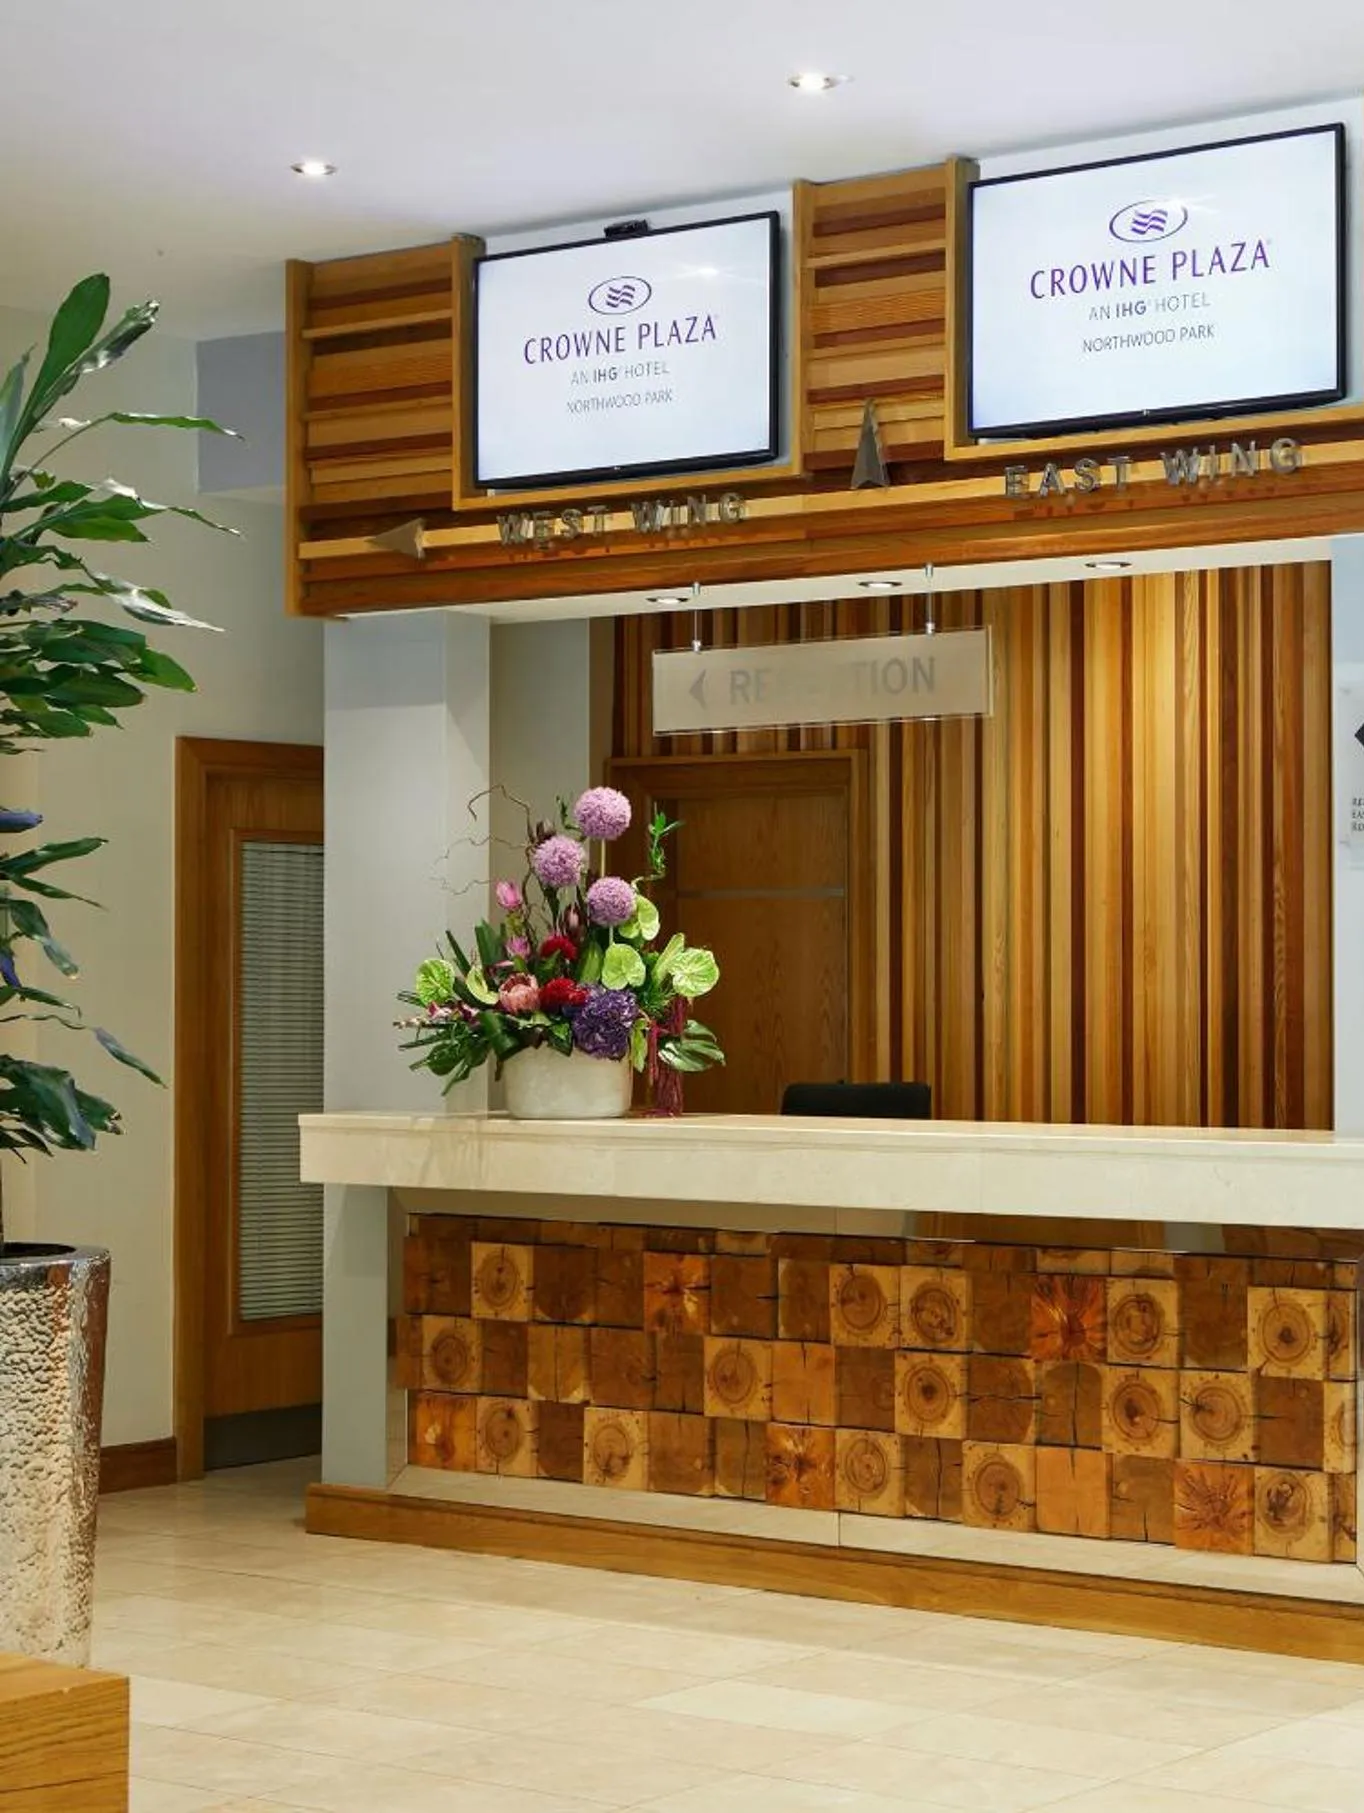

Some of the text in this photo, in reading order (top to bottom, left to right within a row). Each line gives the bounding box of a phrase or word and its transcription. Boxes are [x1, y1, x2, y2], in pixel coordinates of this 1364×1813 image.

[1030, 238, 1270, 300] CROWNE PLAZA
[1089, 292, 1211, 321] AN IHG HOTEL
[524, 314, 717, 365] CROWNE PLAZA
[1083, 324, 1215, 353] NORTHWOOD PARK
[571, 361, 670, 386] AN IHG HOTEL
[567, 387, 673, 413] NORTHWOOD PARK
[1004, 437, 1303, 499] EAST WING
[497, 492, 747, 547] WEST WING
[730, 656, 936, 706] RETION
